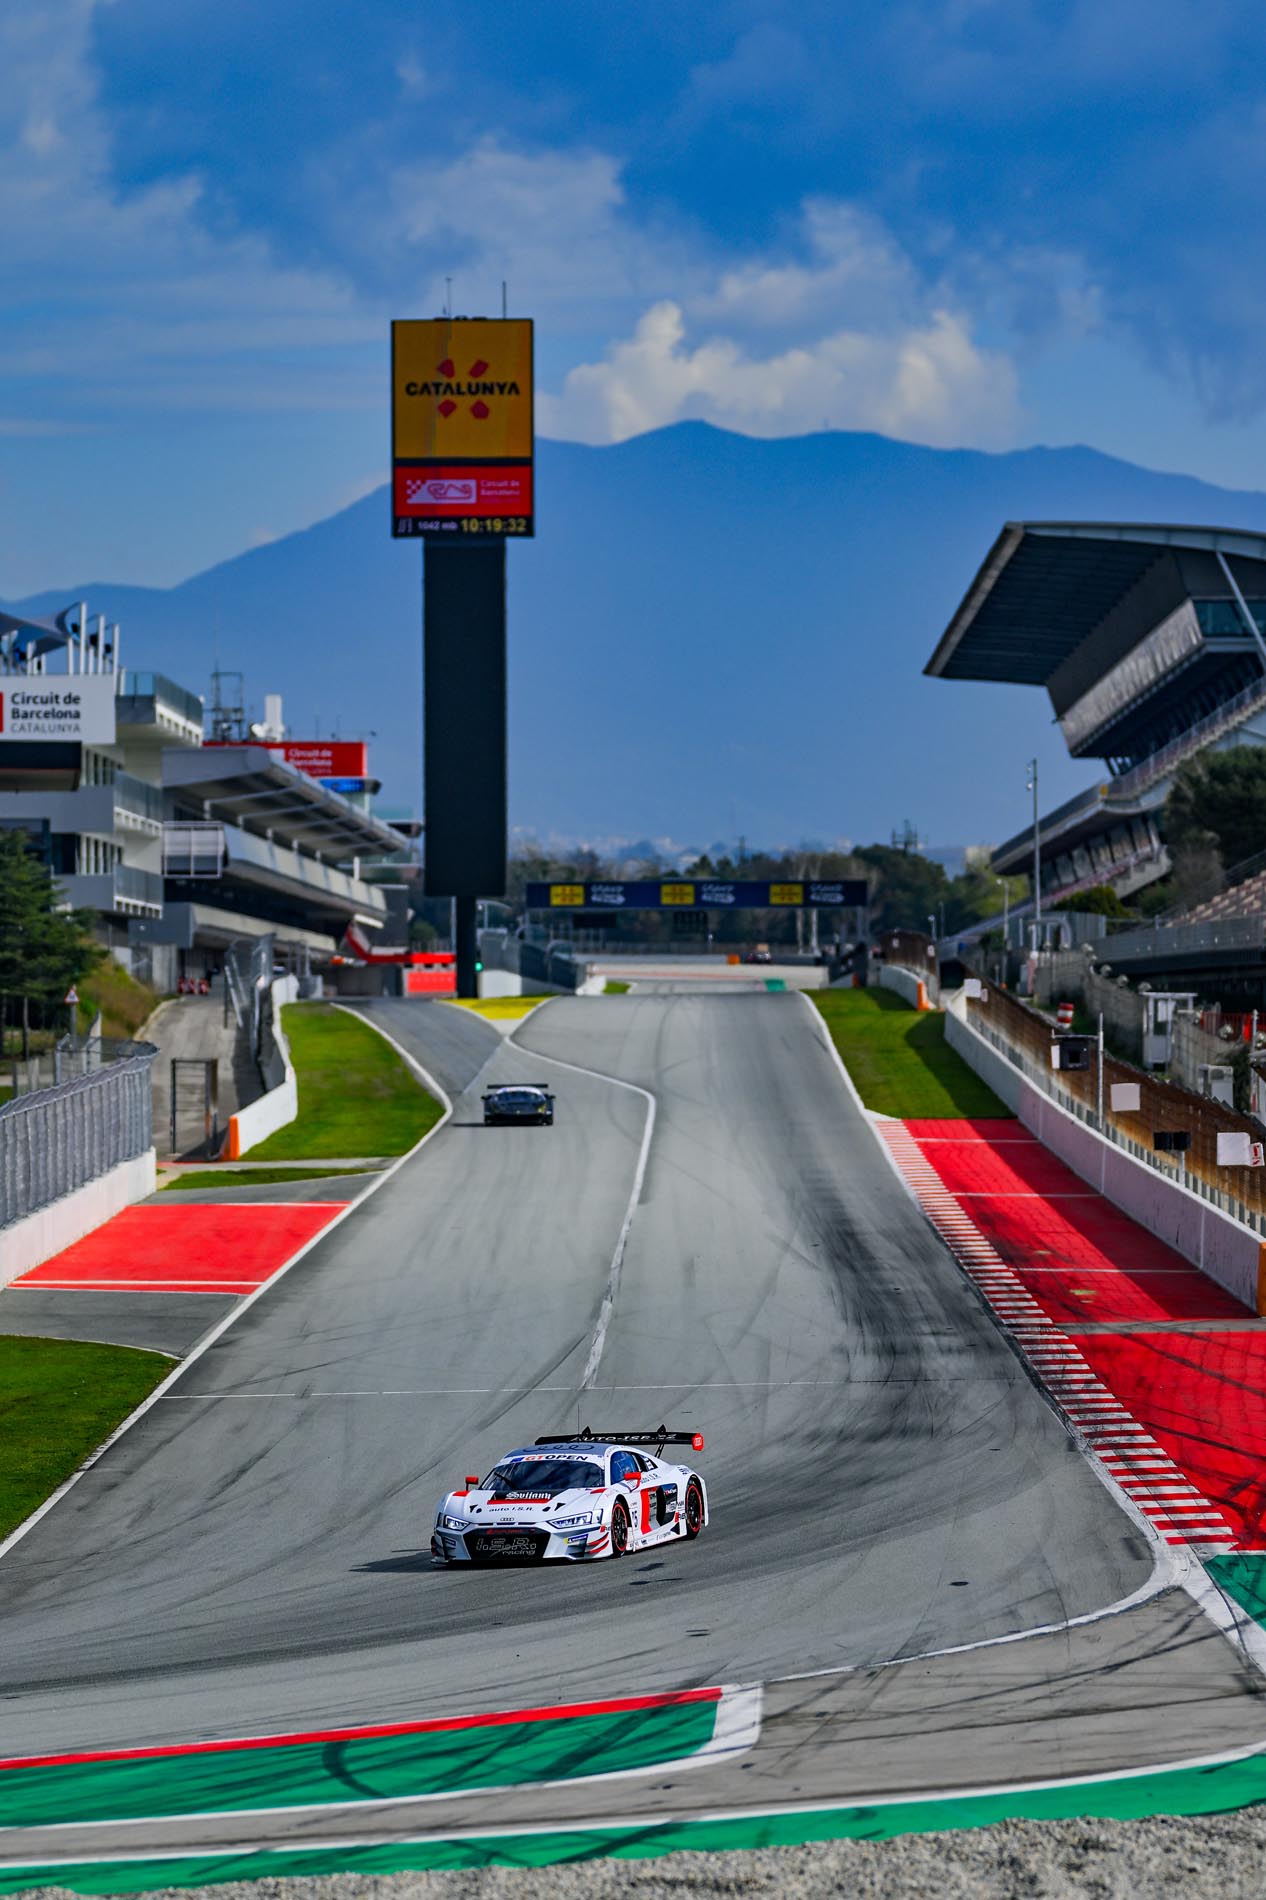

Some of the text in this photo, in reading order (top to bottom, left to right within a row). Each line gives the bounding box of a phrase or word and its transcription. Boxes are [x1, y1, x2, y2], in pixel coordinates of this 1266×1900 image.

[405, 382, 520, 396] CATALUNYA
[461, 518, 527, 532] 10:19:32
[11, 692, 81, 704] Circuit de
[11, 707, 81, 719] Barcelona
[11, 722, 81, 733] CATALUNYA
